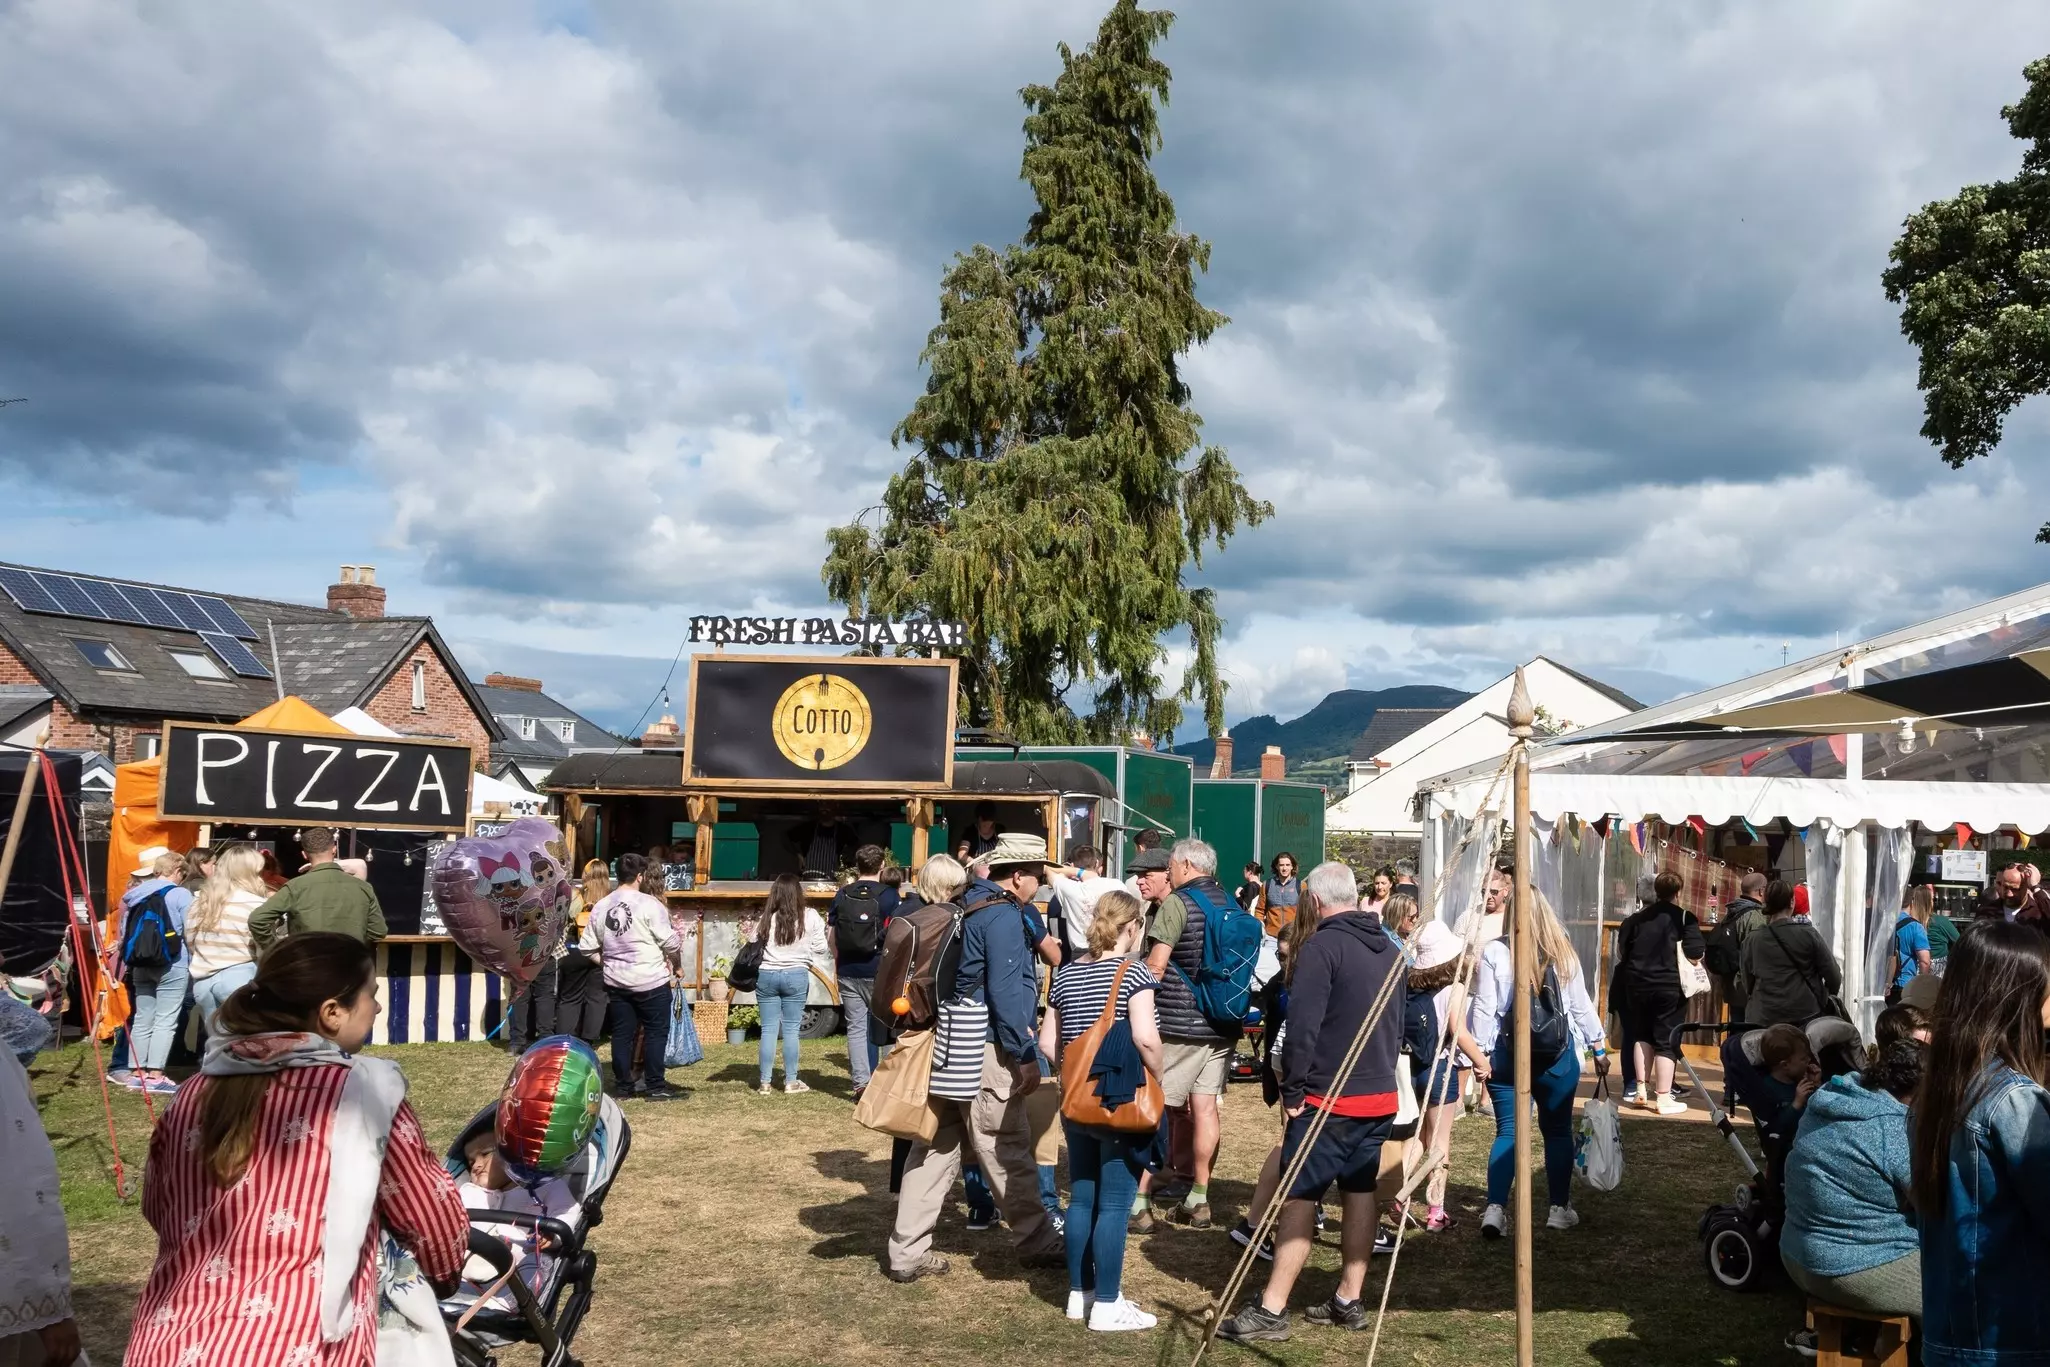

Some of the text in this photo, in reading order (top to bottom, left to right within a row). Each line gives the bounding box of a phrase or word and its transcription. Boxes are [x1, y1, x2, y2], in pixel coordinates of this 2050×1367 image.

[688, 615, 971, 648] FRESH PASTA BAR
[196, 733, 452, 815] PIZZA
